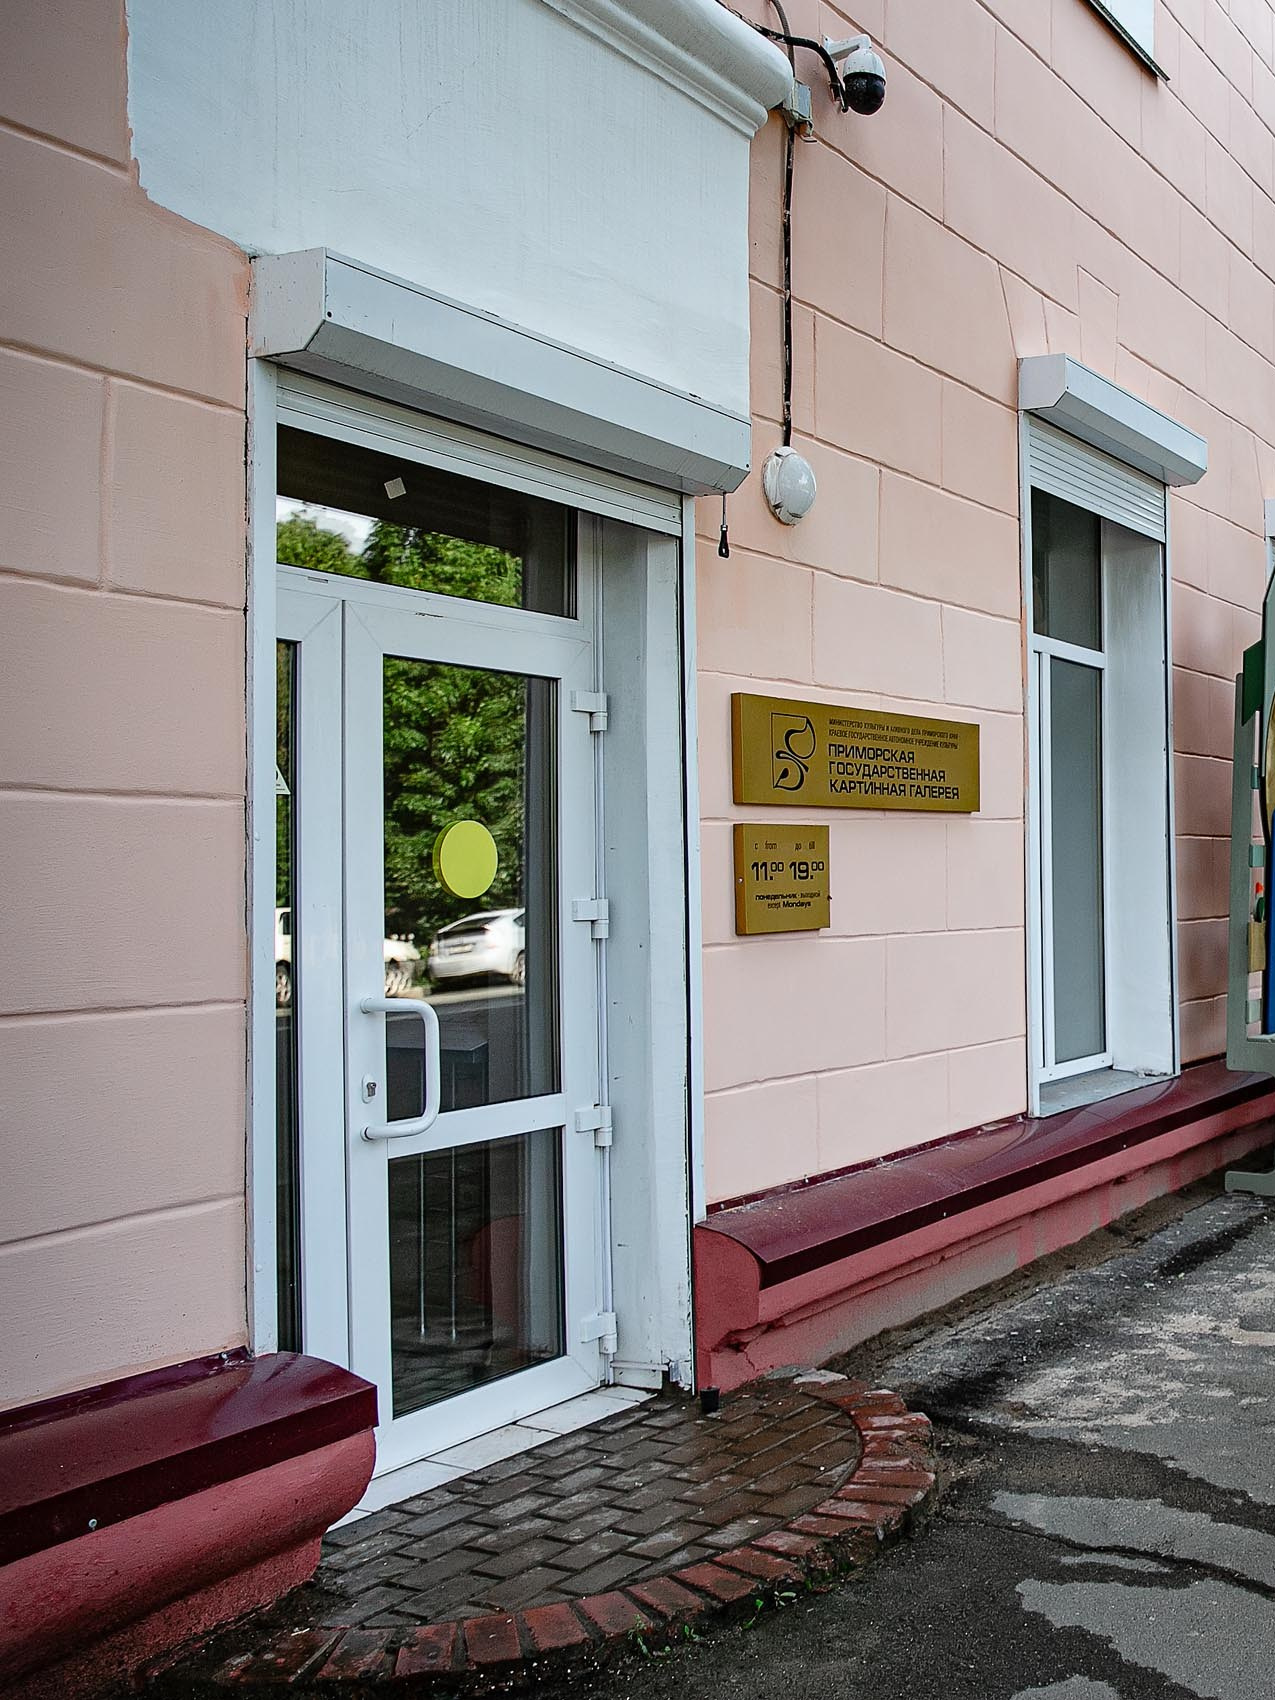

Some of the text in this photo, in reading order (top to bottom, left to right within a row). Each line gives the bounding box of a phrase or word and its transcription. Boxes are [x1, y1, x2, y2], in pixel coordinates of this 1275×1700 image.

[829, 718, 863, 729] МИНИСТЕРСТВО
[863, 722, 886, 731] КУЛЬТУРЫ
[828, 728, 848, 738] КРАЕВОЕ
[848, 731, 888, 742] ГОСУДАРСТВЕННОЕ
[828, 743, 915, 763] ПРИМОРСКАЯ
[828, 761, 945, 782] ГОСУДАРСТВЕННАЯ
[829, 779, 960, 799] КАРТИННАЯ ГАЛЕРЕЯ
[765, 841, 777, 850] from
[751, 861, 825, 881] 11.00 19.00
[755, 893, 797, 901] понедельник
